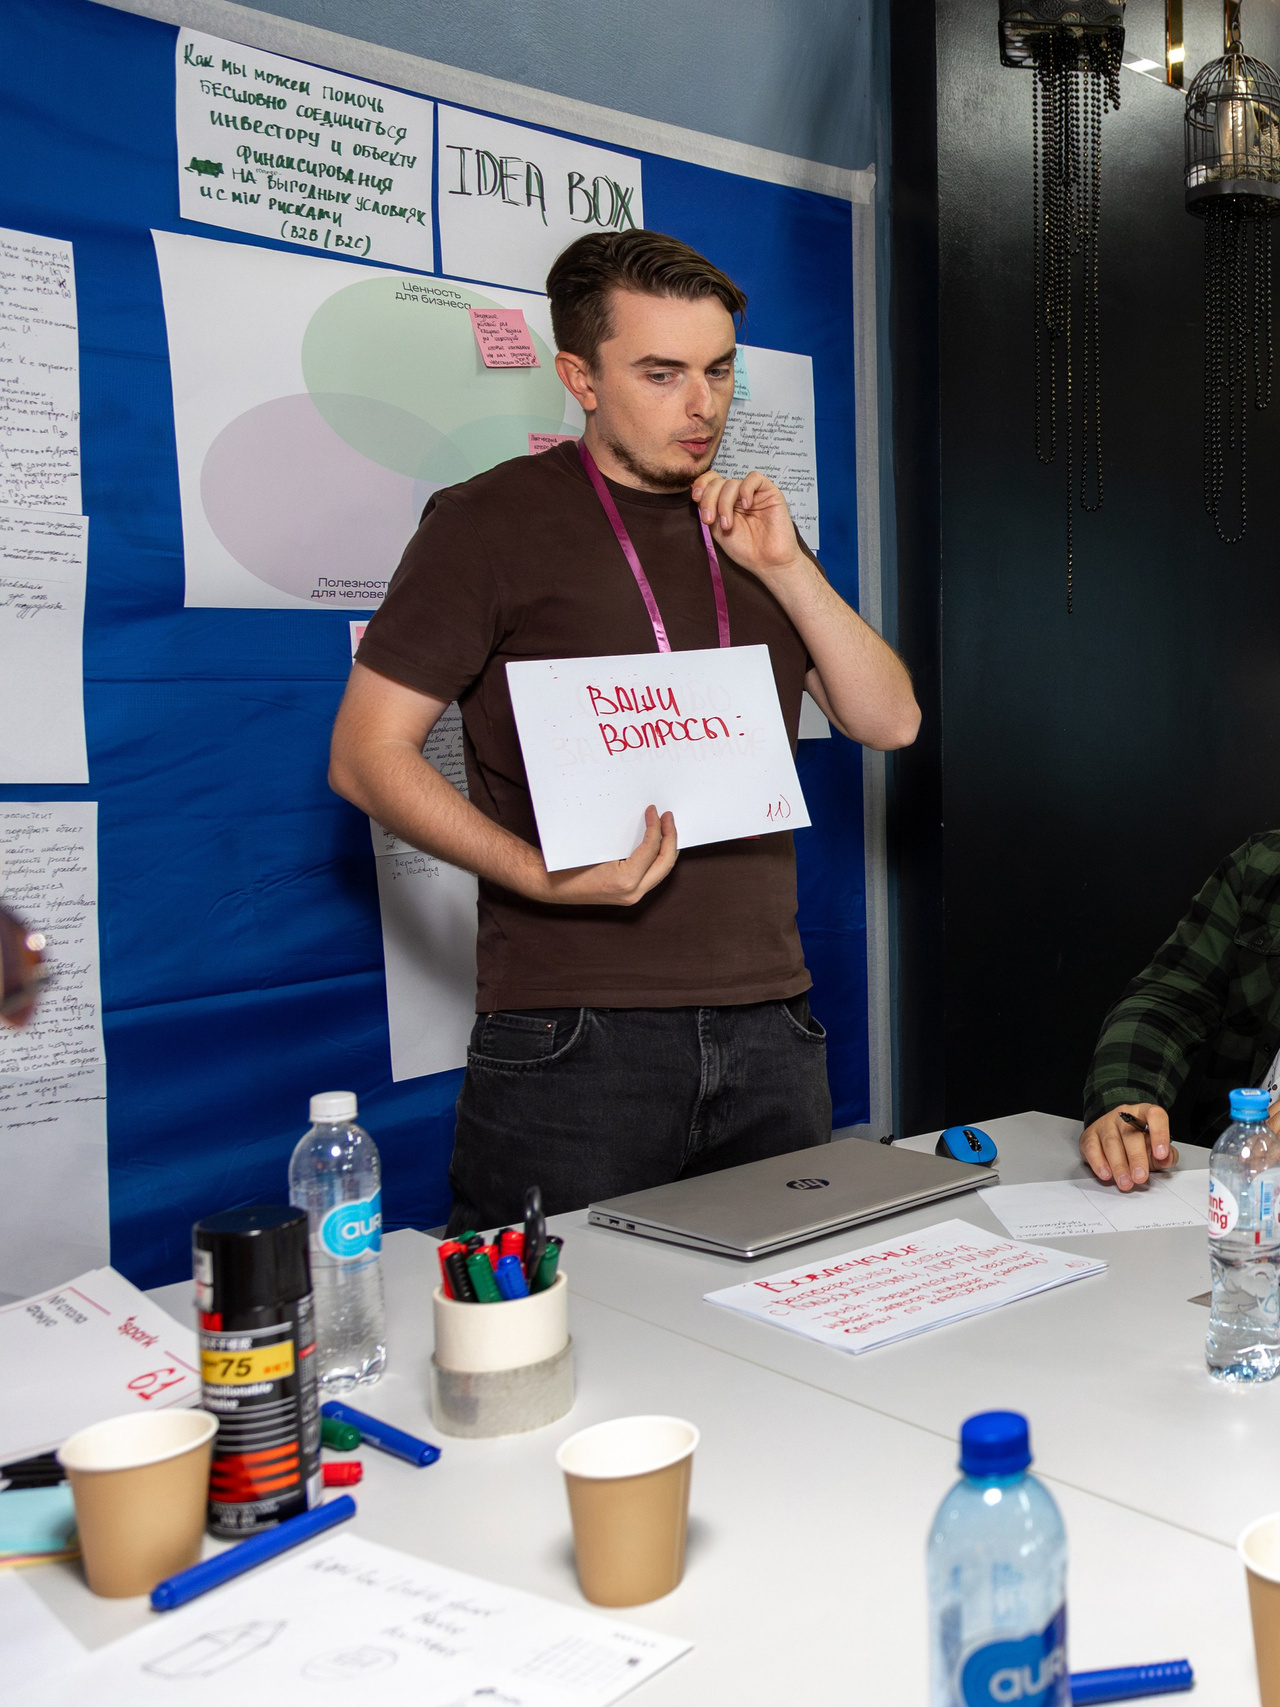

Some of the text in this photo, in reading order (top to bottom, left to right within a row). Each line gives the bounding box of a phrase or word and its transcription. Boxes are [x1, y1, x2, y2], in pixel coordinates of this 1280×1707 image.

[184, 43, 214, 67] Как
[231, 167, 257, 185] НА
[446, 144, 637, 232] IDEA BOX
[395, 290, 473, 310] для бизнеса
[401, 281, 463, 300] Ценность
[310, 590, 387, 599] для челове
